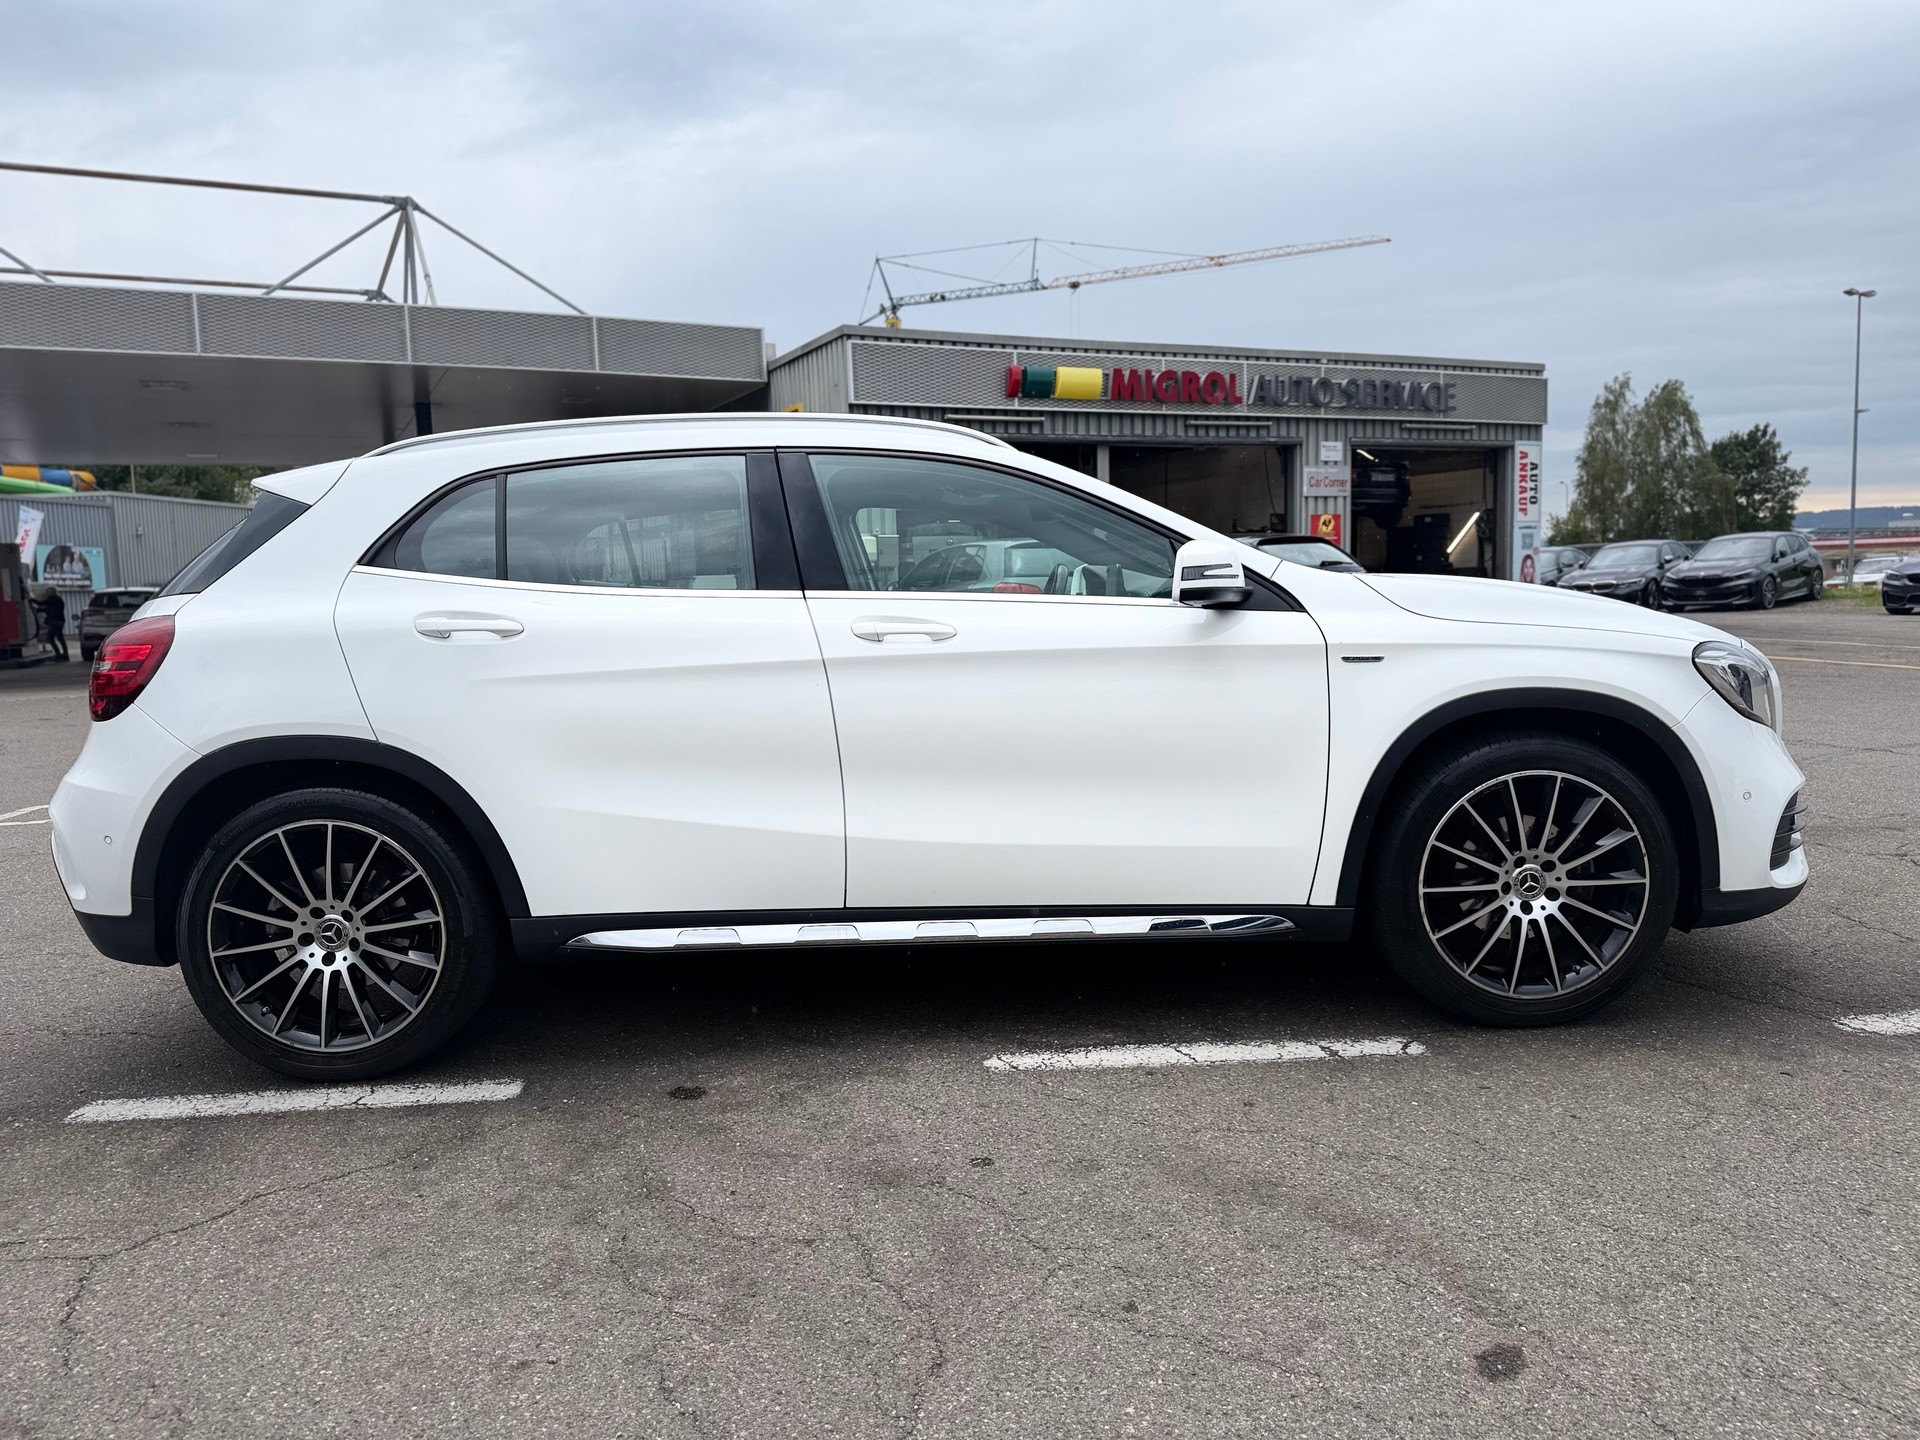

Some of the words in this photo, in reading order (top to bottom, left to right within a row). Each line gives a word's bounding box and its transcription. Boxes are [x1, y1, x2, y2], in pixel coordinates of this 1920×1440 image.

[1110, 367, 1243, 405] MIGROL
[1249, 374, 1334, 407] AUTO
[1342, 377, 1457, 412] SERVICE
[1519, 449, 1529, 516] ANKAUF
[1529, 461, 1539, 504] AUTO
